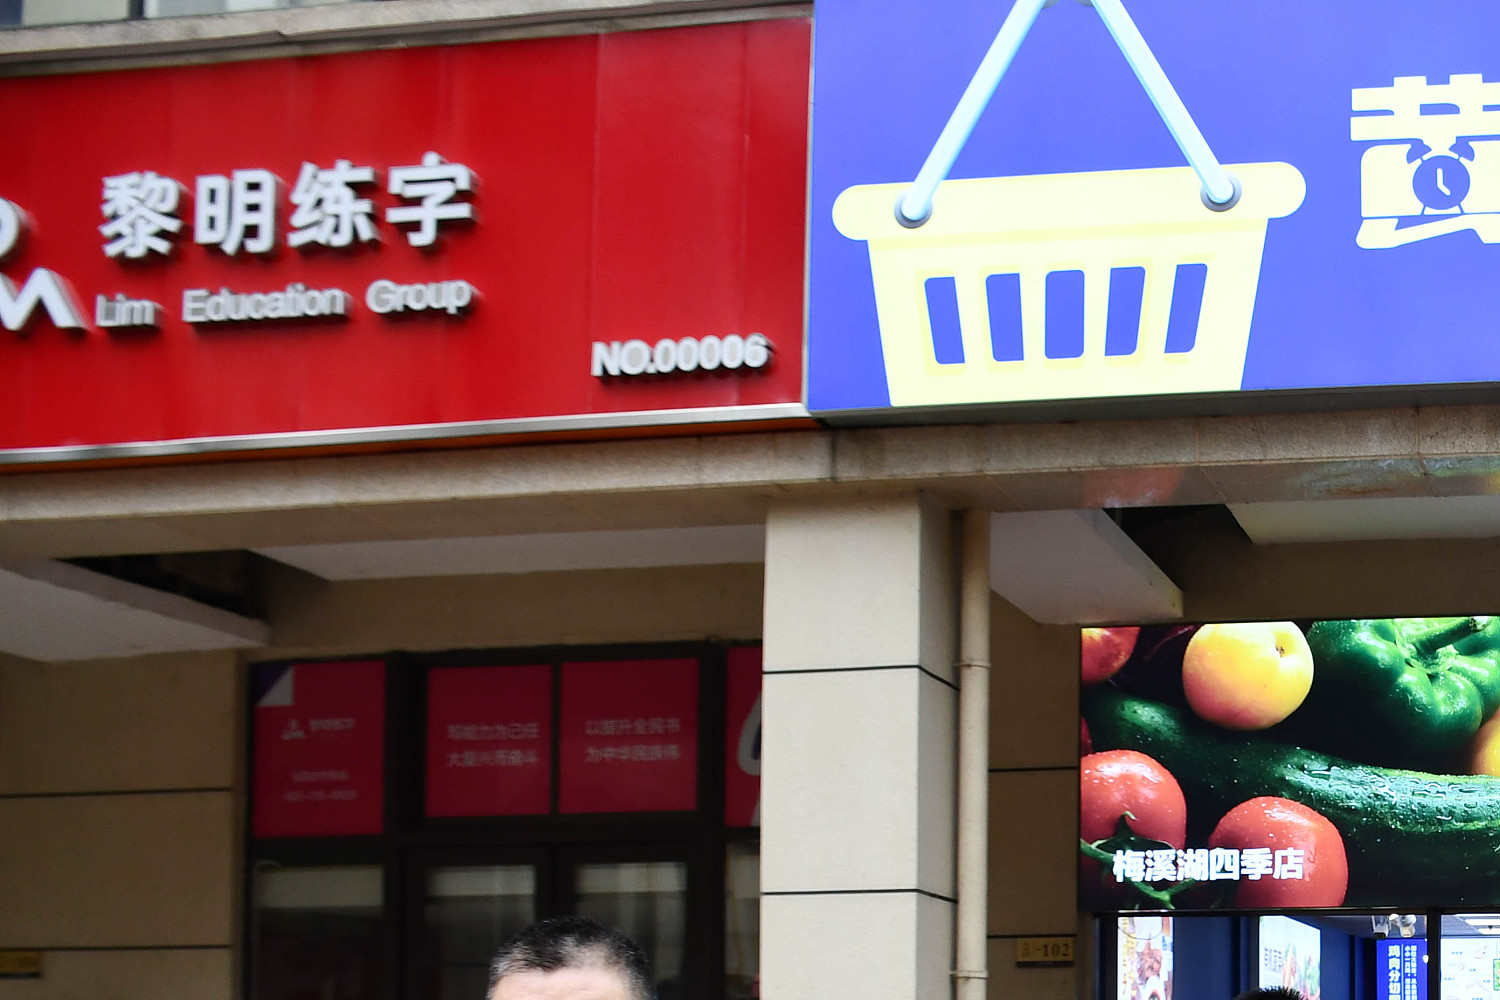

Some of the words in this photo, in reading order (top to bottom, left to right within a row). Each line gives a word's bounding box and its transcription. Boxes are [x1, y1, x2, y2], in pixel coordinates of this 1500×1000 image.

[99, 152, 475, 260] 黎明练字
[95, 293, 157, 328] Lim
[182, 283, 346, 324] Education
[366, 279, 473, 316] Group
[592, 333, 770, 378] NO.00006
[1111, 848, 1305, 883] 梅溪湖四季店
